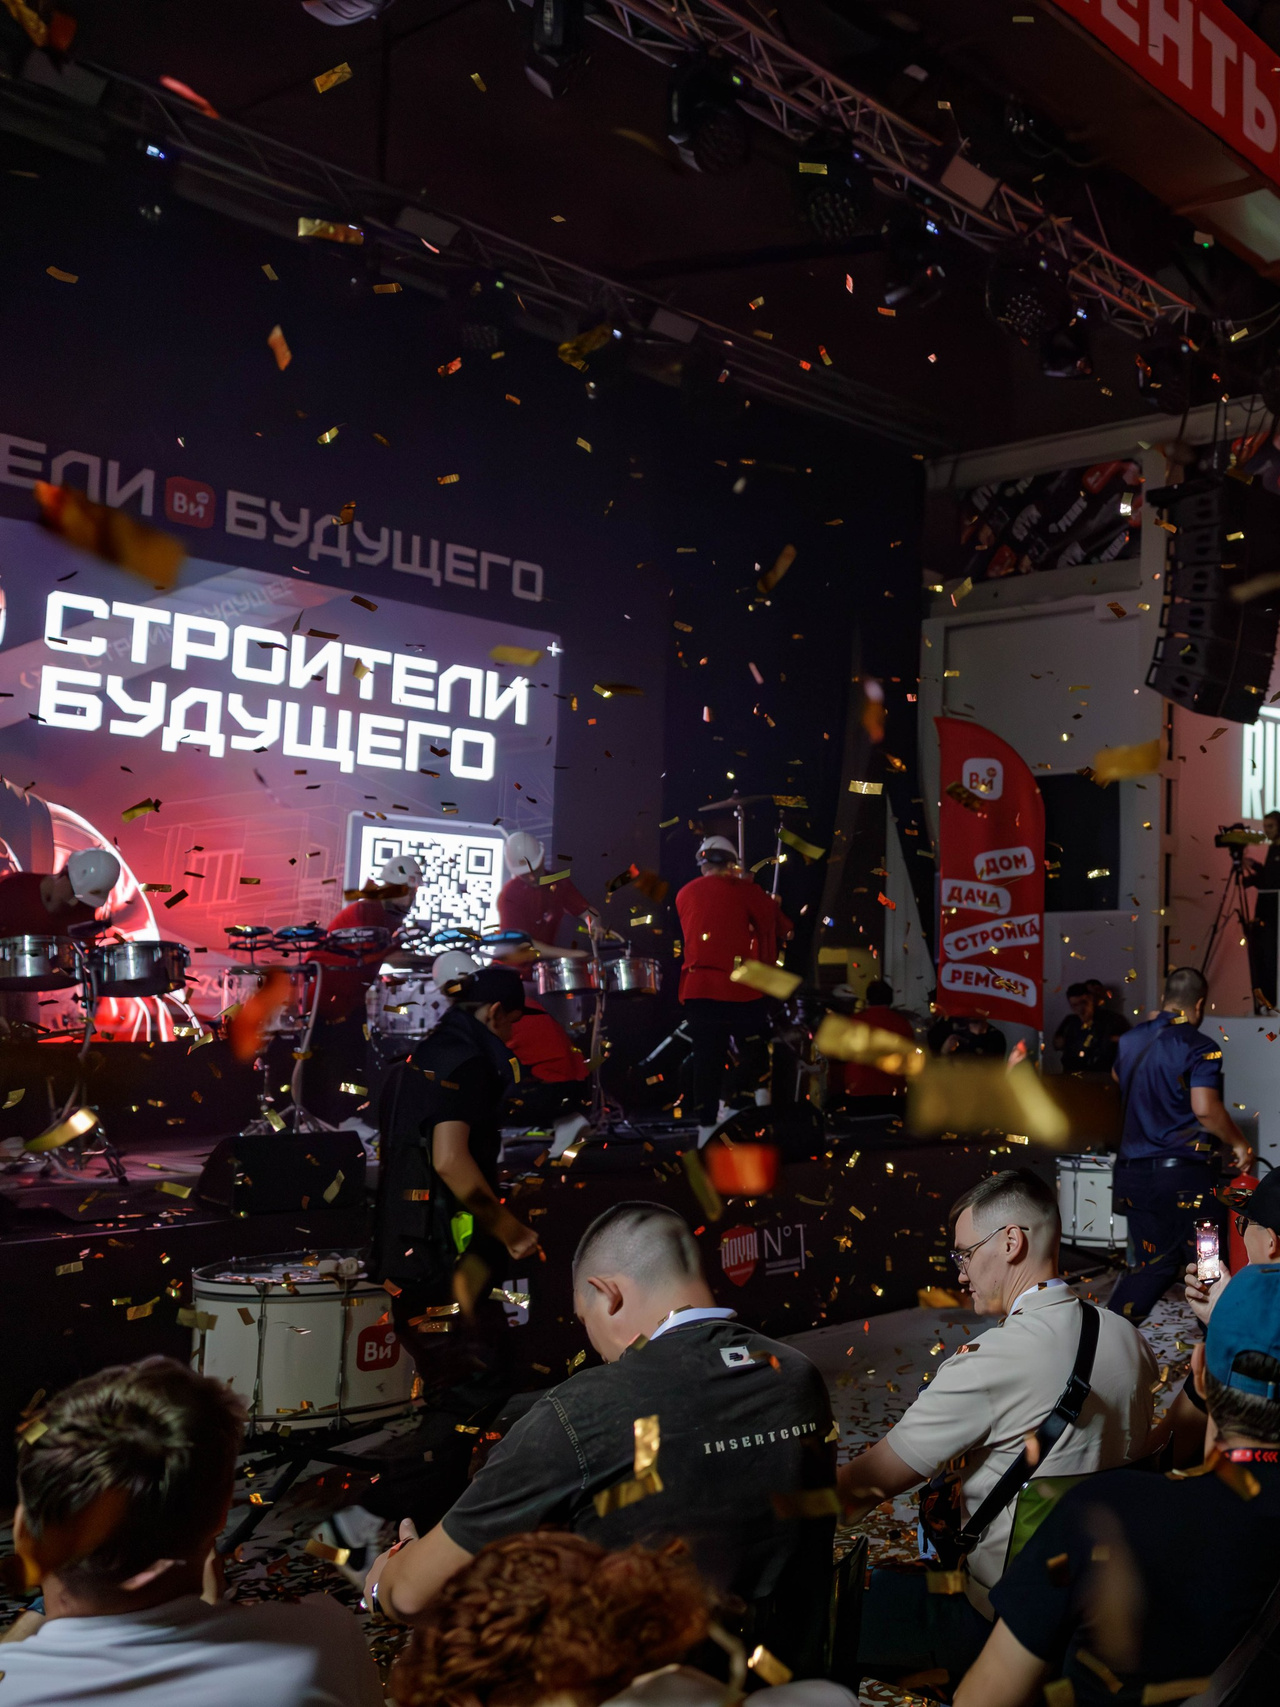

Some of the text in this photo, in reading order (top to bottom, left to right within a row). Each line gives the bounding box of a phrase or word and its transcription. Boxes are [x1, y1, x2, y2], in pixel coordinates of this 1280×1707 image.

[226, 490, 544, 602] БУДУЩЕГО
[45, 590, 530, 725] СТРОИТЕЛИ
[38, 664, 496, 781] БУДУЩЕГО
[985, 853, 1028, 876] ДОМ
[947, 885, 1001, 909] ДАЧА
[954, 919, 1040, 952] СТРОЙКА
[950, 968, 1030, 998] РЕМОНТ
